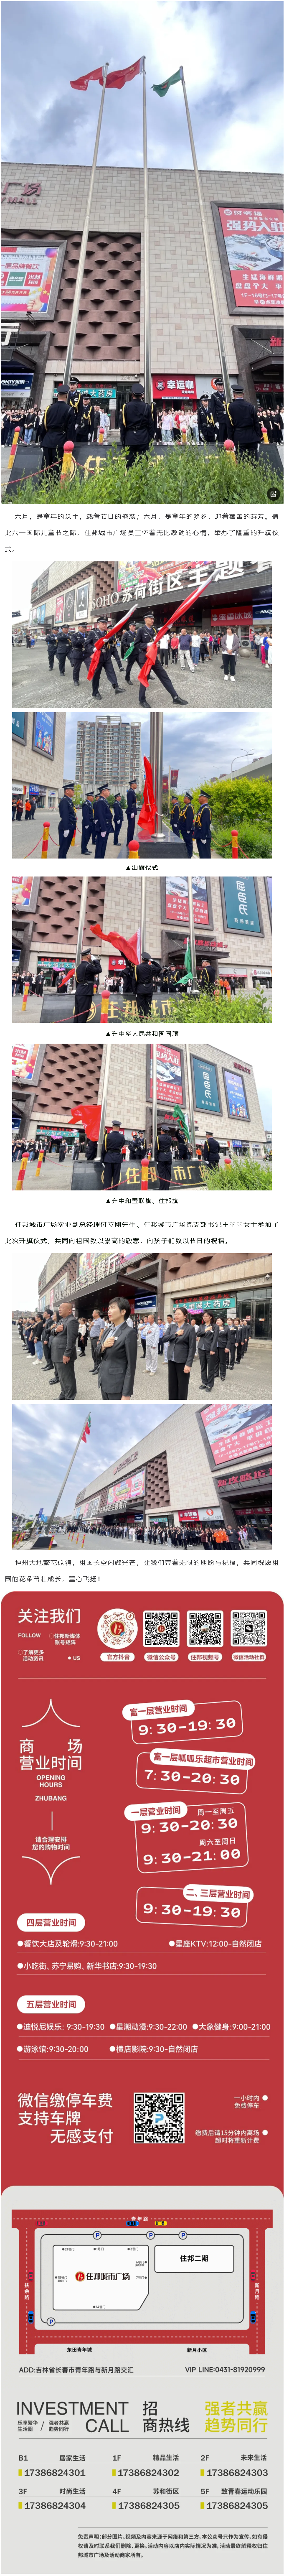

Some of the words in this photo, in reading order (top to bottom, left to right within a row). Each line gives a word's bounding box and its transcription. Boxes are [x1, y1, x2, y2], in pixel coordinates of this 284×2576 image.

[226, 220, 284, 232] 强势入驻
[270, 336, 282, 347] 新
[167, 380, 194, 390] 幸运咖
[92, 592, 119, 609] SOHO
[218, 612, 252, 621] 蜜雪冰城
[236, 880, 248, 915] 屈臣氏
[203, 1072, 211, 1099] 屈臣氏
[241, 1277, 265, 1286] 22号门
[183, 1299, 231, 1310] 永恒诚大药房
